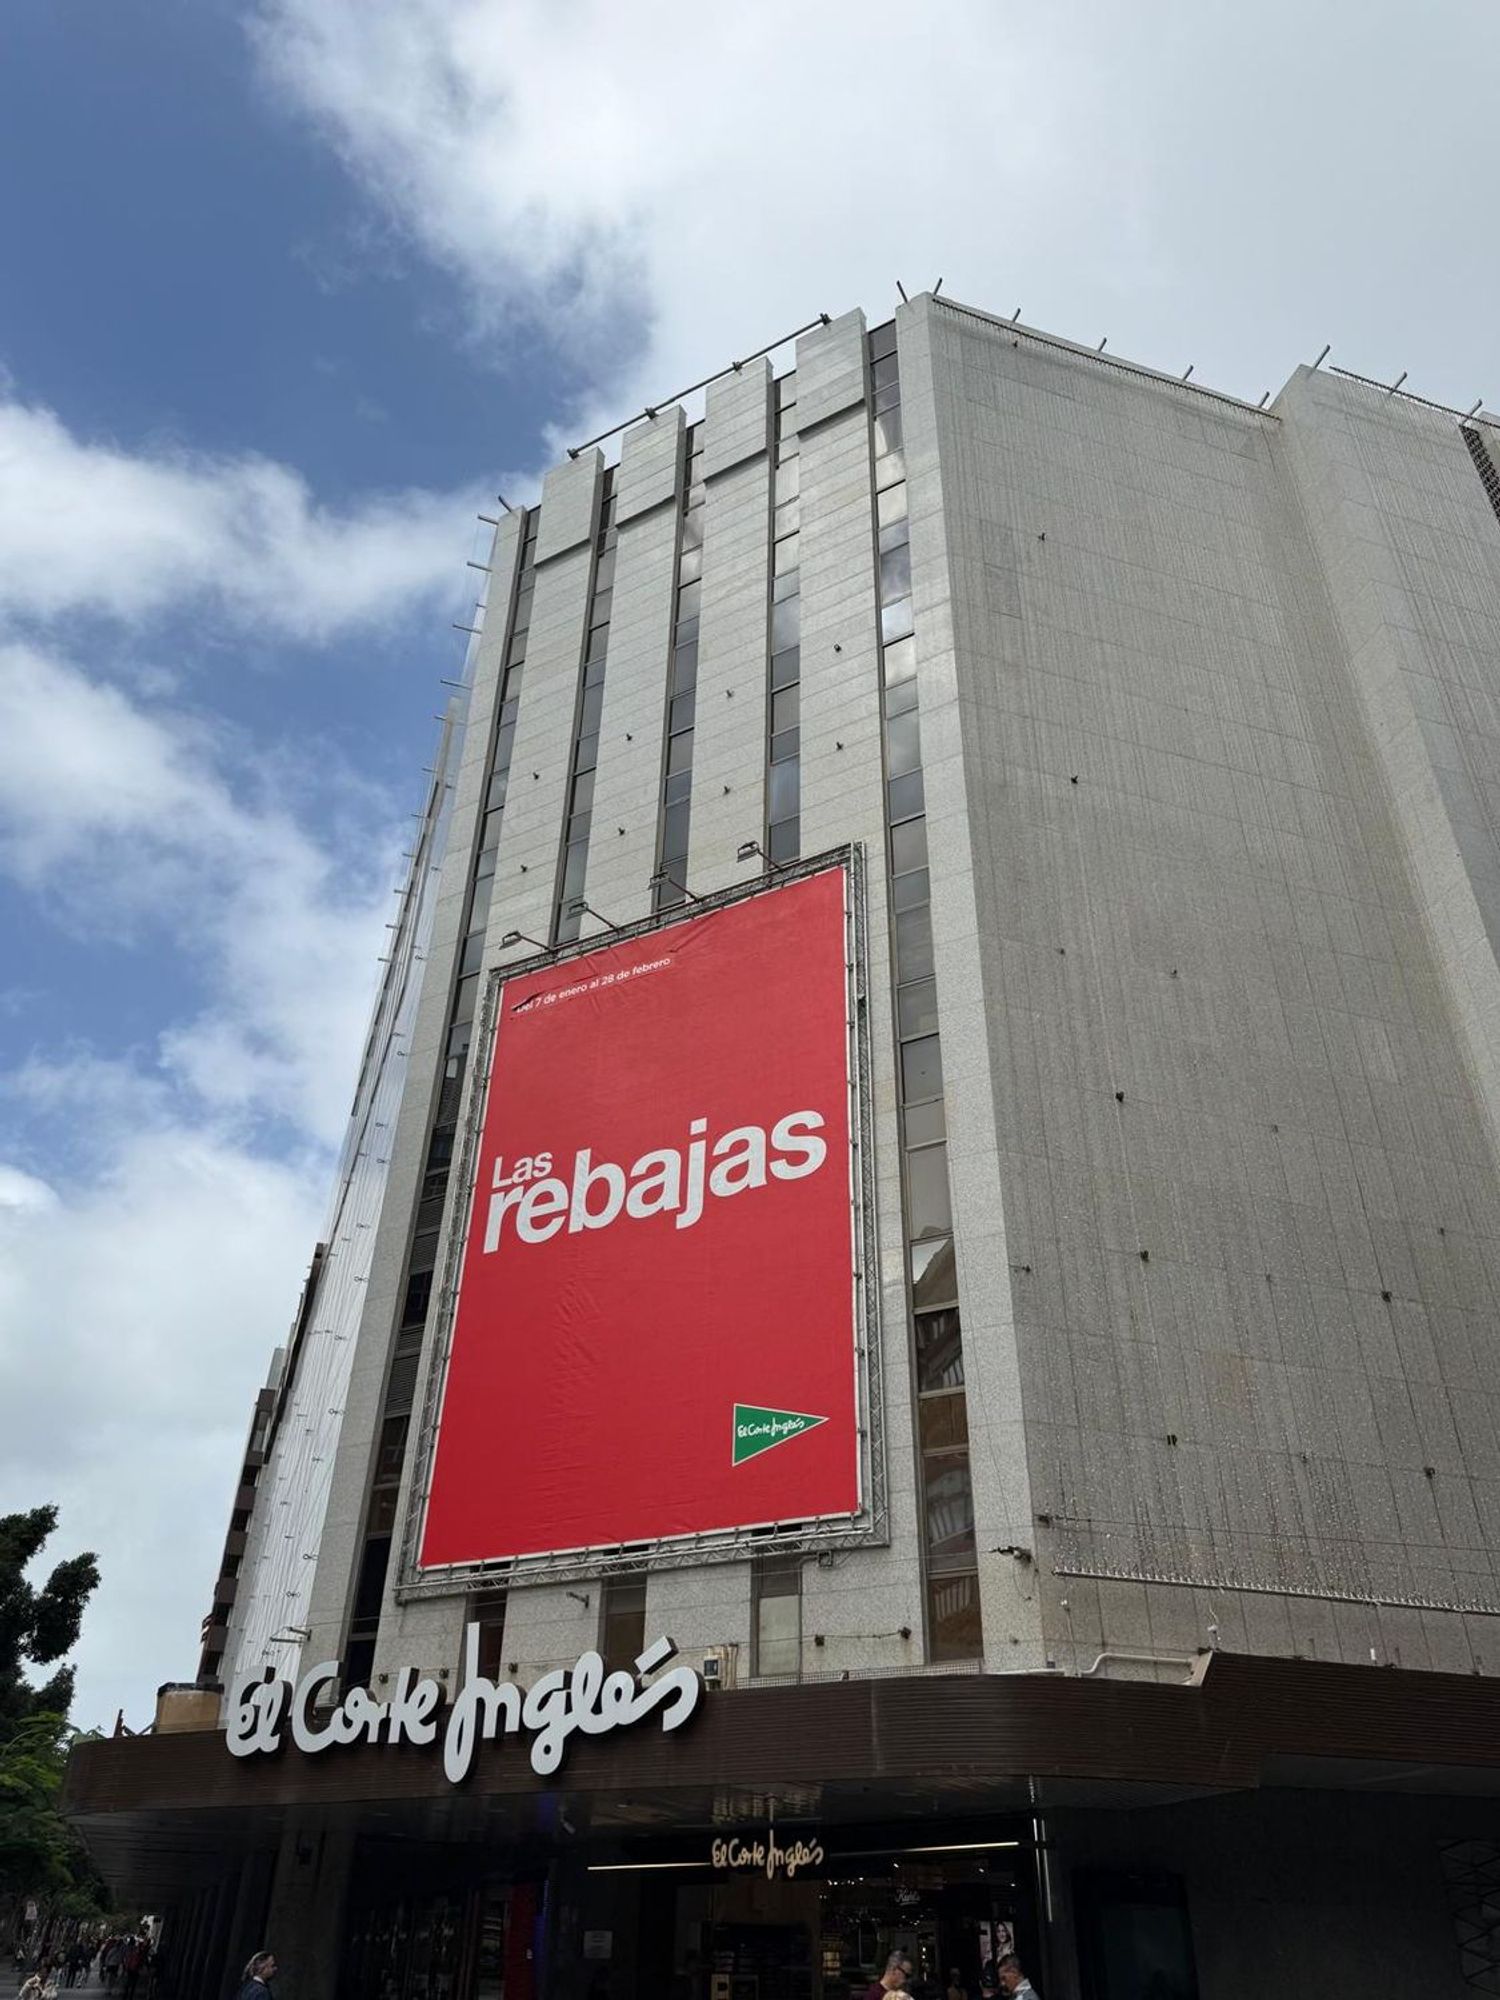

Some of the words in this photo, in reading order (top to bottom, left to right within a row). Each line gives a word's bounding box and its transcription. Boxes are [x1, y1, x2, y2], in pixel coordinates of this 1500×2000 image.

[535, 997, 542, 1008] 7
[543, 992, 557, 1005] de
[559, 984, 588, 999] enero
[589, 978, 599, 989] al
[601, 973, 615, 986] 28
[616, 970, 631, 981] de
[632, 958, 671, 975] febrero
[482, 1109, 828, 1255] rebajas
[491, 1151, 553, 1190] Las
[225, 1664, 294, 1758] El
[291, 1659, 448, 1754] Corte
[443, 1621, 701, 1784] Inglés
[712, 1838, 727, 1868] El
[728, 1838, 765, 1867] Corte
[766, 1829, 824, 1880] Inglés
